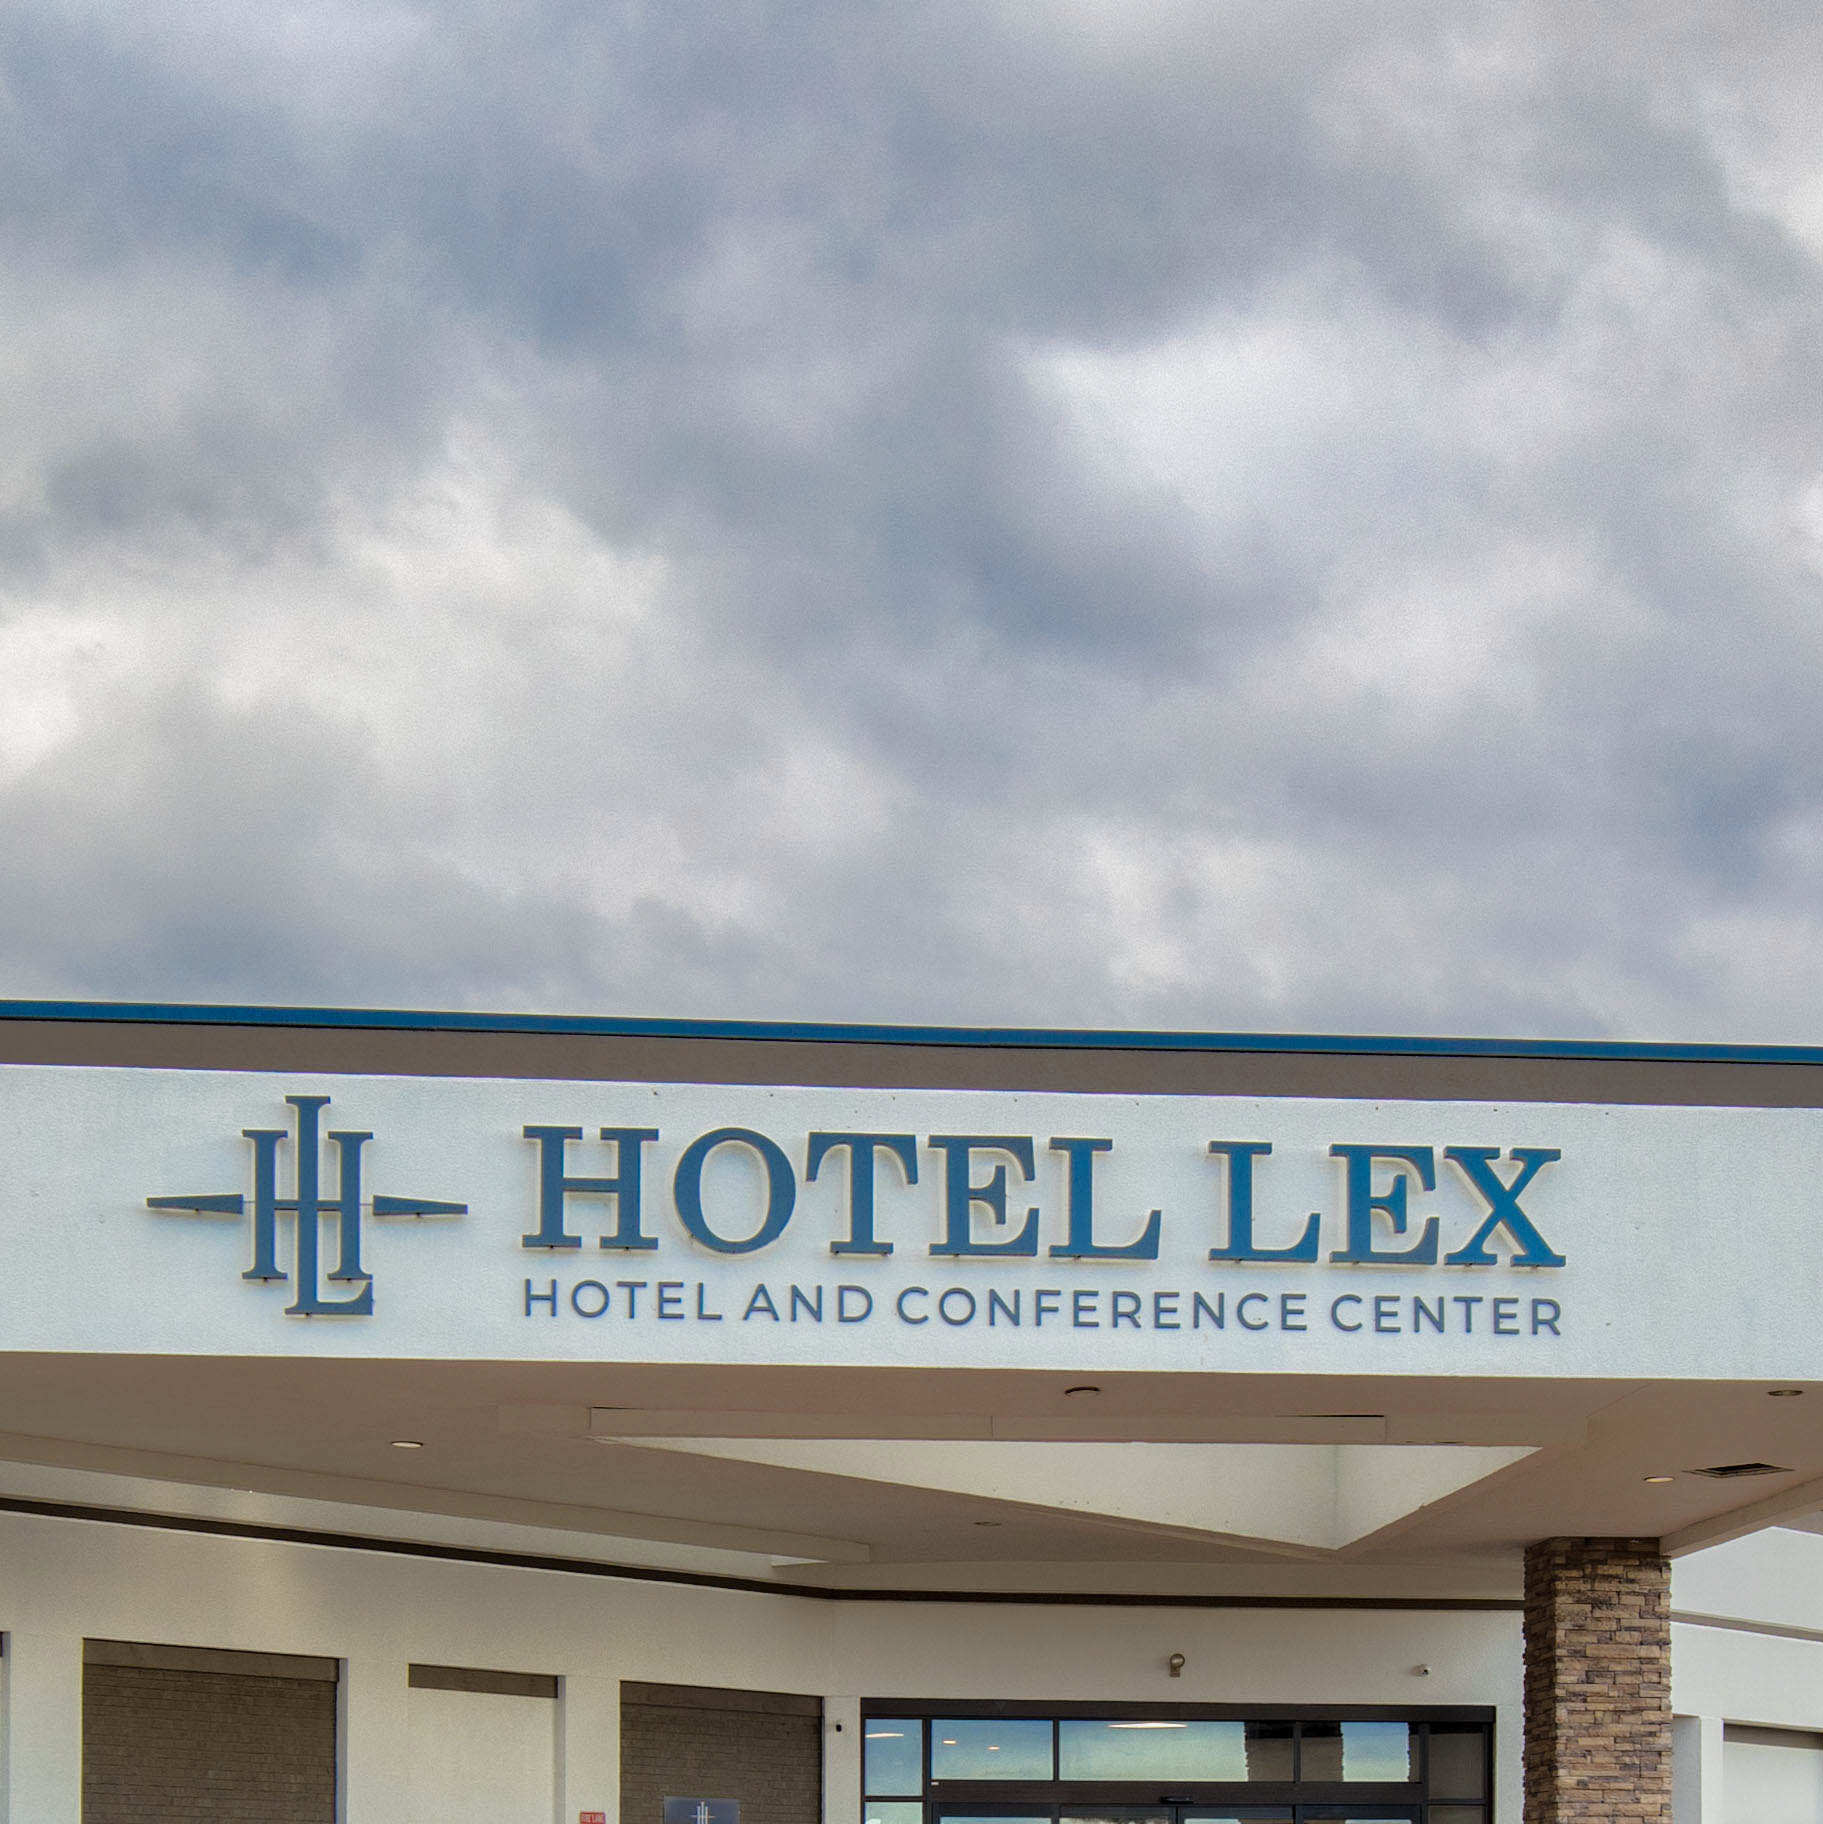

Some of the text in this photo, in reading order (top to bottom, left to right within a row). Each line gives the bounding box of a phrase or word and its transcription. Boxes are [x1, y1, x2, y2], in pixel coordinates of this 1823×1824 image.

[521, 1125, 1567, 1270] HOTEL LEX
[523, 1278, 1562, 1336] HOTEL AND CONFERENCE CENTER
